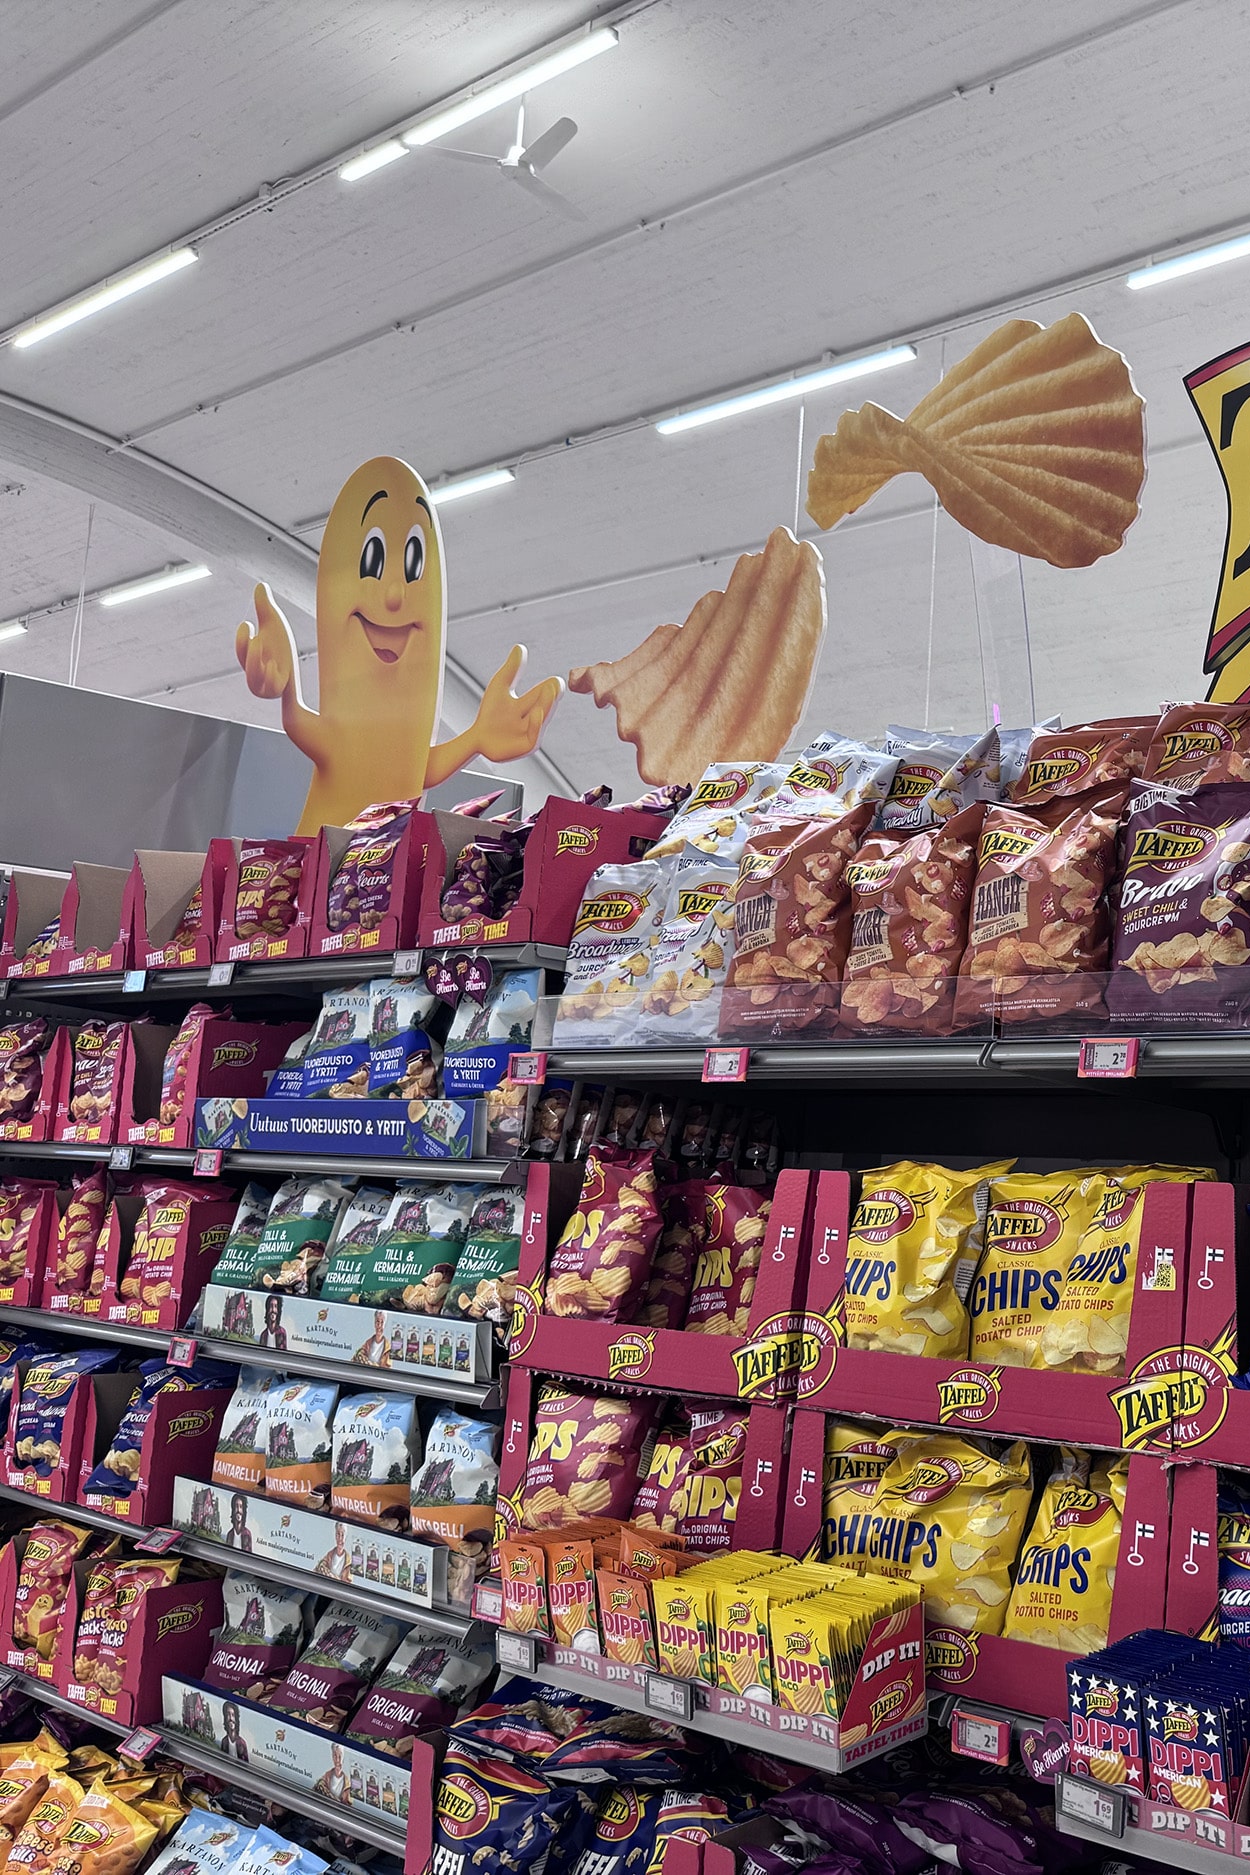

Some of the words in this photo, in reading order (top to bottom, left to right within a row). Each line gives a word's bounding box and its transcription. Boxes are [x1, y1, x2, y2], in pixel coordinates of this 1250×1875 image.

[1134, 795, 1149, 810] BIG
[1149, 790, 1168, 803] TIME
[236, 890, 265, 909] SIPS
[976, 875, 1020, 921] RANCH
[1121, 873, 1204, 908] Bravo
[1122, 906, 1150, 923] SWEET
[1152, 901, 1177, 915] CHILI
[1178, 898, 1188, 910] &
[145, 950, 164, 967] TAFFEL
[179, 948, 196, 965] TIME!
[567, 939, 645, 960] Broadway
[470, 967, 480, 979] Be
[465, 980, 486, 992] Hearts
[304, 1055, 353, 1069] TUOREJUUSTO
[453, 1071, 461, 1080] &
[462, 1069, 481, 1081] YRTIT
[250, 1112, 289, 1134] Uutuus
[291, 1118, 362, 1136] TUOREJUUSTO
[365, 1121, 374, 1135] &
[376, 1119, 406, 1137] YRTIT
[1005, 1204, 1020, 1213] THE
[1024, 1202, 1055, 1224] ORIGINAL
[385, 1249, 404, 1261] TILLI
[406, 1251, 414, 1262] &
[997, 1260, 1034, 1268] CLASSIC
[373, 1262, 422, 1276] KERMAVIILI
[971, 1269, 1063, 1318] CHIPS
[1066, 1286, 1100, 1297] SALTED
[109, 1306, 126, 1320] TAFFEL
[142, 1309, 159, 1325] TIME!
[689, 1303, 709, 1313] POTATO
[711, 1299, 727, 1310] CHIPS
[992, 1313, 1032, 1327] SALTED
[975, 1329, 1012, 1344] POTATO
[1016, 1326, 1047, 1339] CHIPS
[214, 1460, 261, 1482] KANTARELLI
[678, 1475, 743, 1521] SIPS
[692, 1524, 729, 1534] ORIGINAL
[705, 1534, 730, 1545] CHIPS
[1018, 1545, 1091, 1595] CHIPS
[234, 1582, 287, 1604] KARTANON
[504, 1579, 544, 1606] DIPPI
[1030, 1591, 1062, 1606] SALTED
[1015, 1605, 1048, 1618] POTATO
[1050, 1608, 1079, 1622] CHIPS
[606, 1635, 627, 1645] RANCH
[661, 1644, 678, 1655] TACO
[212, 1649, 265, 1677] ORIGINAL
[720, 1652, 736, 1663] TACO
[862, 1650, 896, 1682] DIP
[900, 1641, 920, 1660] IT!
[286, 1669, 329, 1700] ORIGINAL
[779, 1679, 798, 1692] TACO
[367, 1695, 421, 1729] ORIGINAL
[719, 1698, 746, 1713] DIP
[749, 1706, 771, 1726] IT!
[844, 1717, 924, 1762] TAFFEL-TIME!
[1032, 1759, 1045, 1777] Be
[1045, 1741, 1070, 1768] Hearts
[1154, 1767, 1201, 1788] AMERICAN
[1094, 1801, 1099, 1816] 1
[1101, 1801, 1112, 1813] 69
[1152, 1811, 1192, 1833] DIP
[1196, 1822, 1226, 1848] IT!
[7, 1847, 36, 1863] Balls
[169, 1839, 226, 1872] KARTANON
